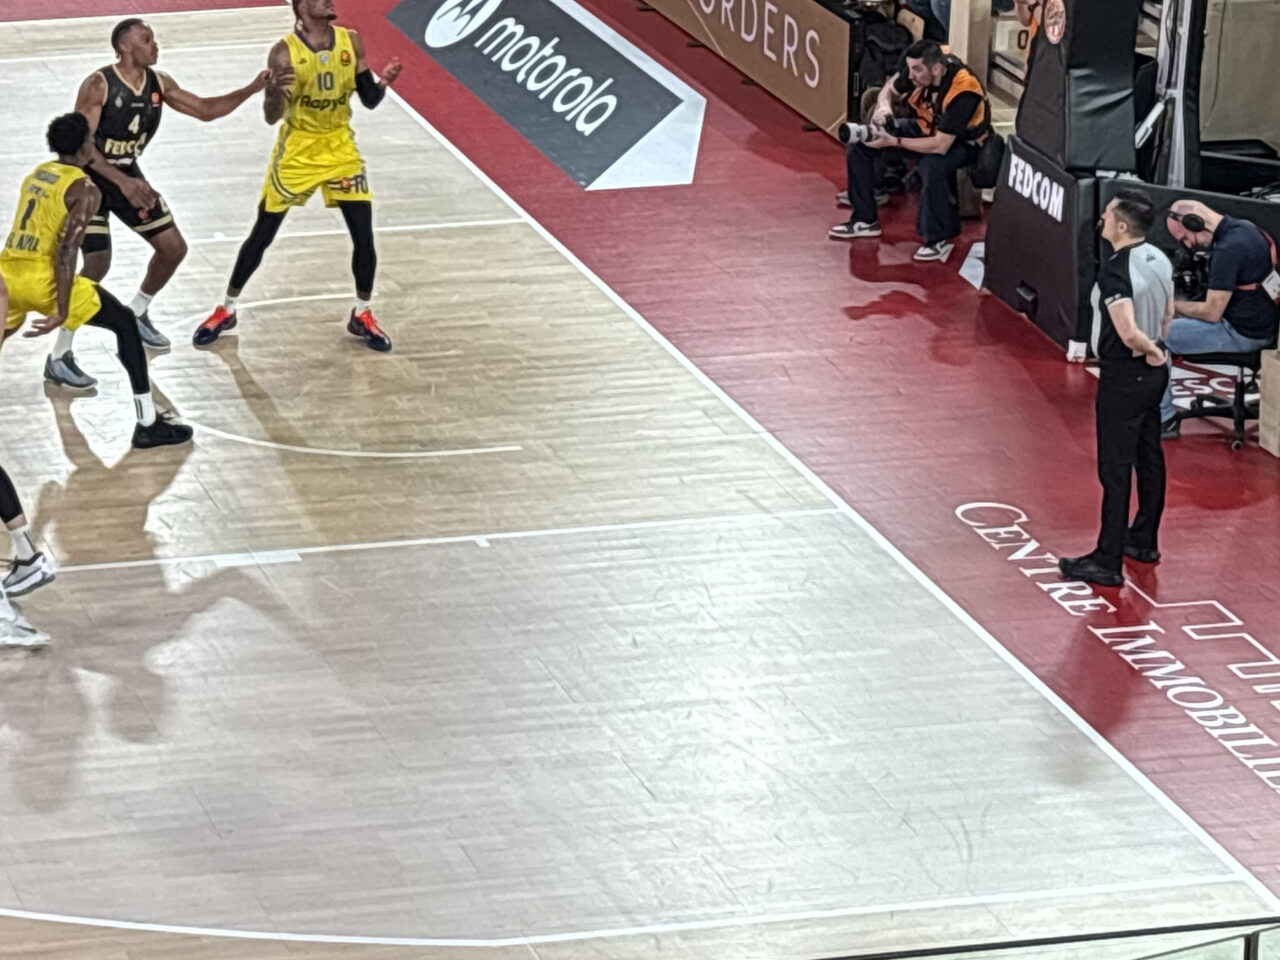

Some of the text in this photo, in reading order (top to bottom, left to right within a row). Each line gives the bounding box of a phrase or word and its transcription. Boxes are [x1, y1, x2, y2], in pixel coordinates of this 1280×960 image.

[317, 71, 334, 91] 10
[474, 16, 619, 137] motorola
[299, 93, 347, 112] Rapyd
[128, 113, 140, 134] 4
[1008, 152, 1066, 223] FEDCOM
[20, 198, 36, 230] 1
[955, 501, 1280, 794] CENTRE IMMOBILI
